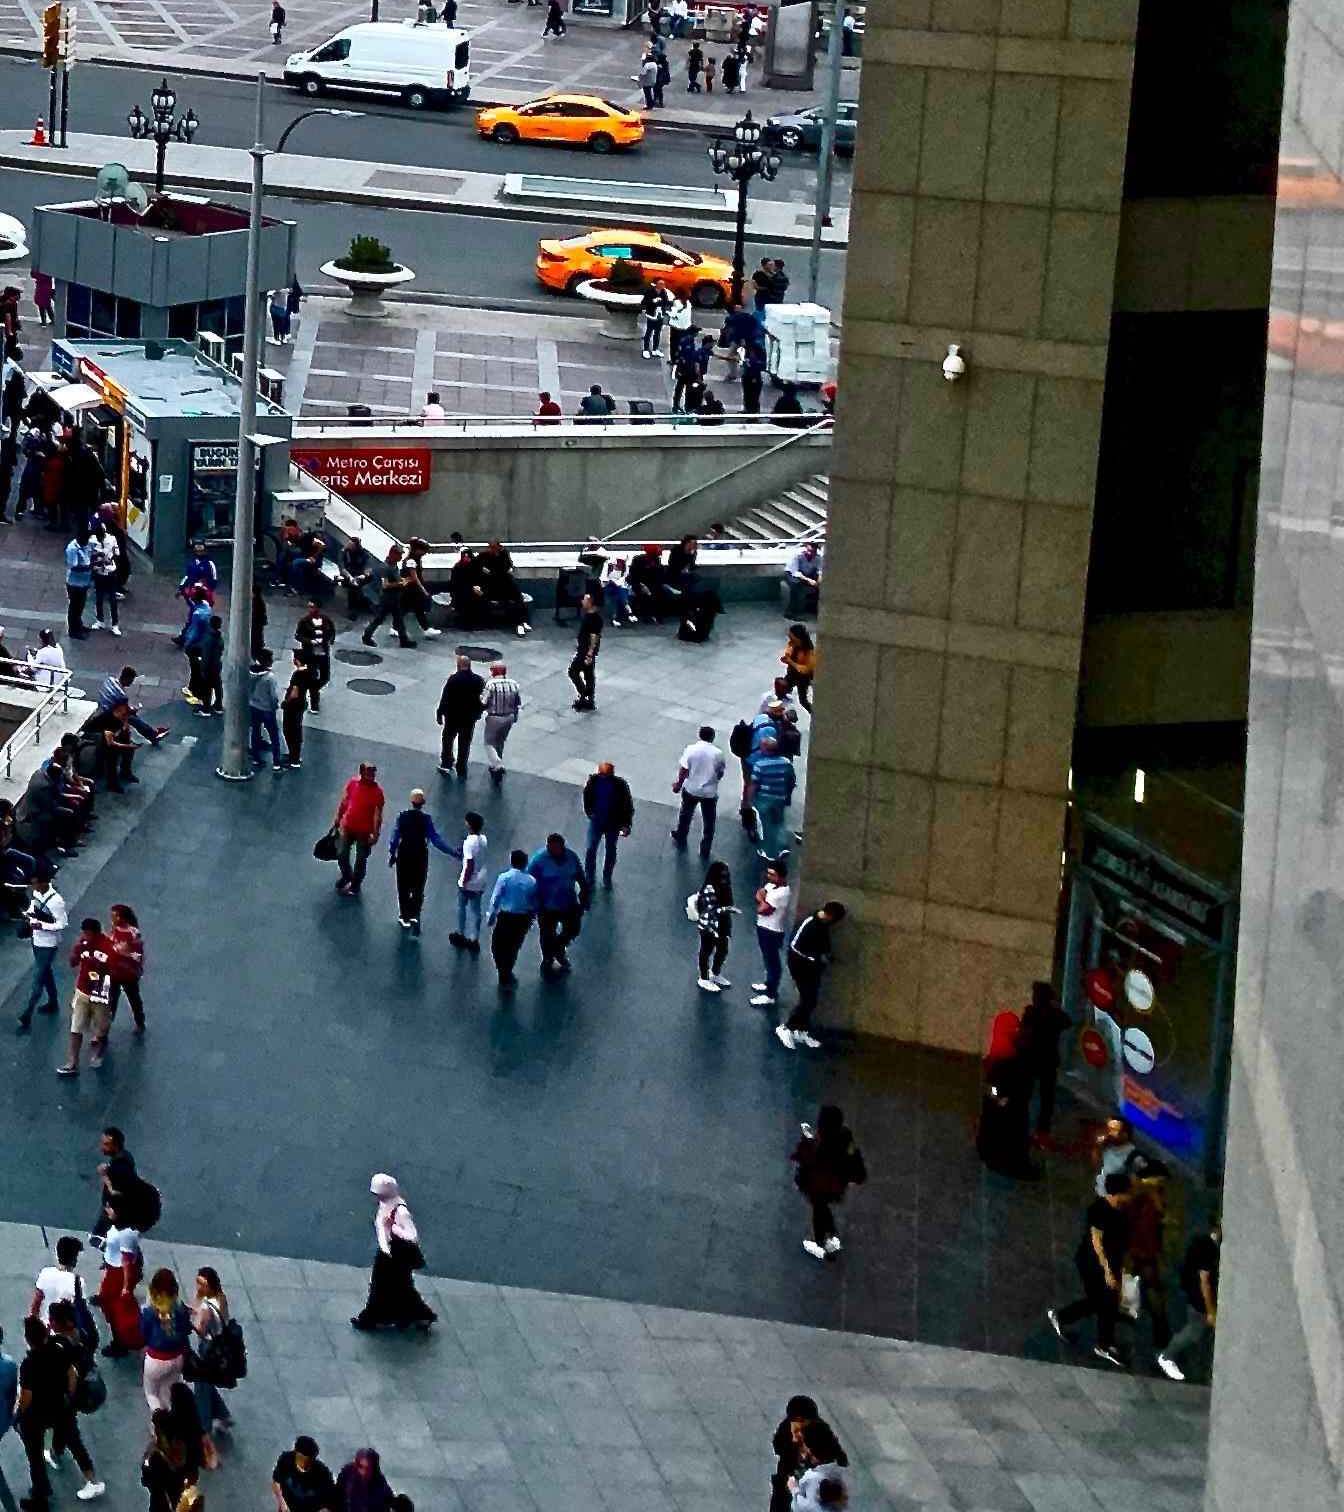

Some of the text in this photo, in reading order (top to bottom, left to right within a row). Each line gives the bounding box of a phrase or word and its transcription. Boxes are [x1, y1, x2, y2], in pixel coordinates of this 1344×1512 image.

[326, 454, 420, 471] Metro Çarşısı
[354, 470, 423, 487] Merkezi
